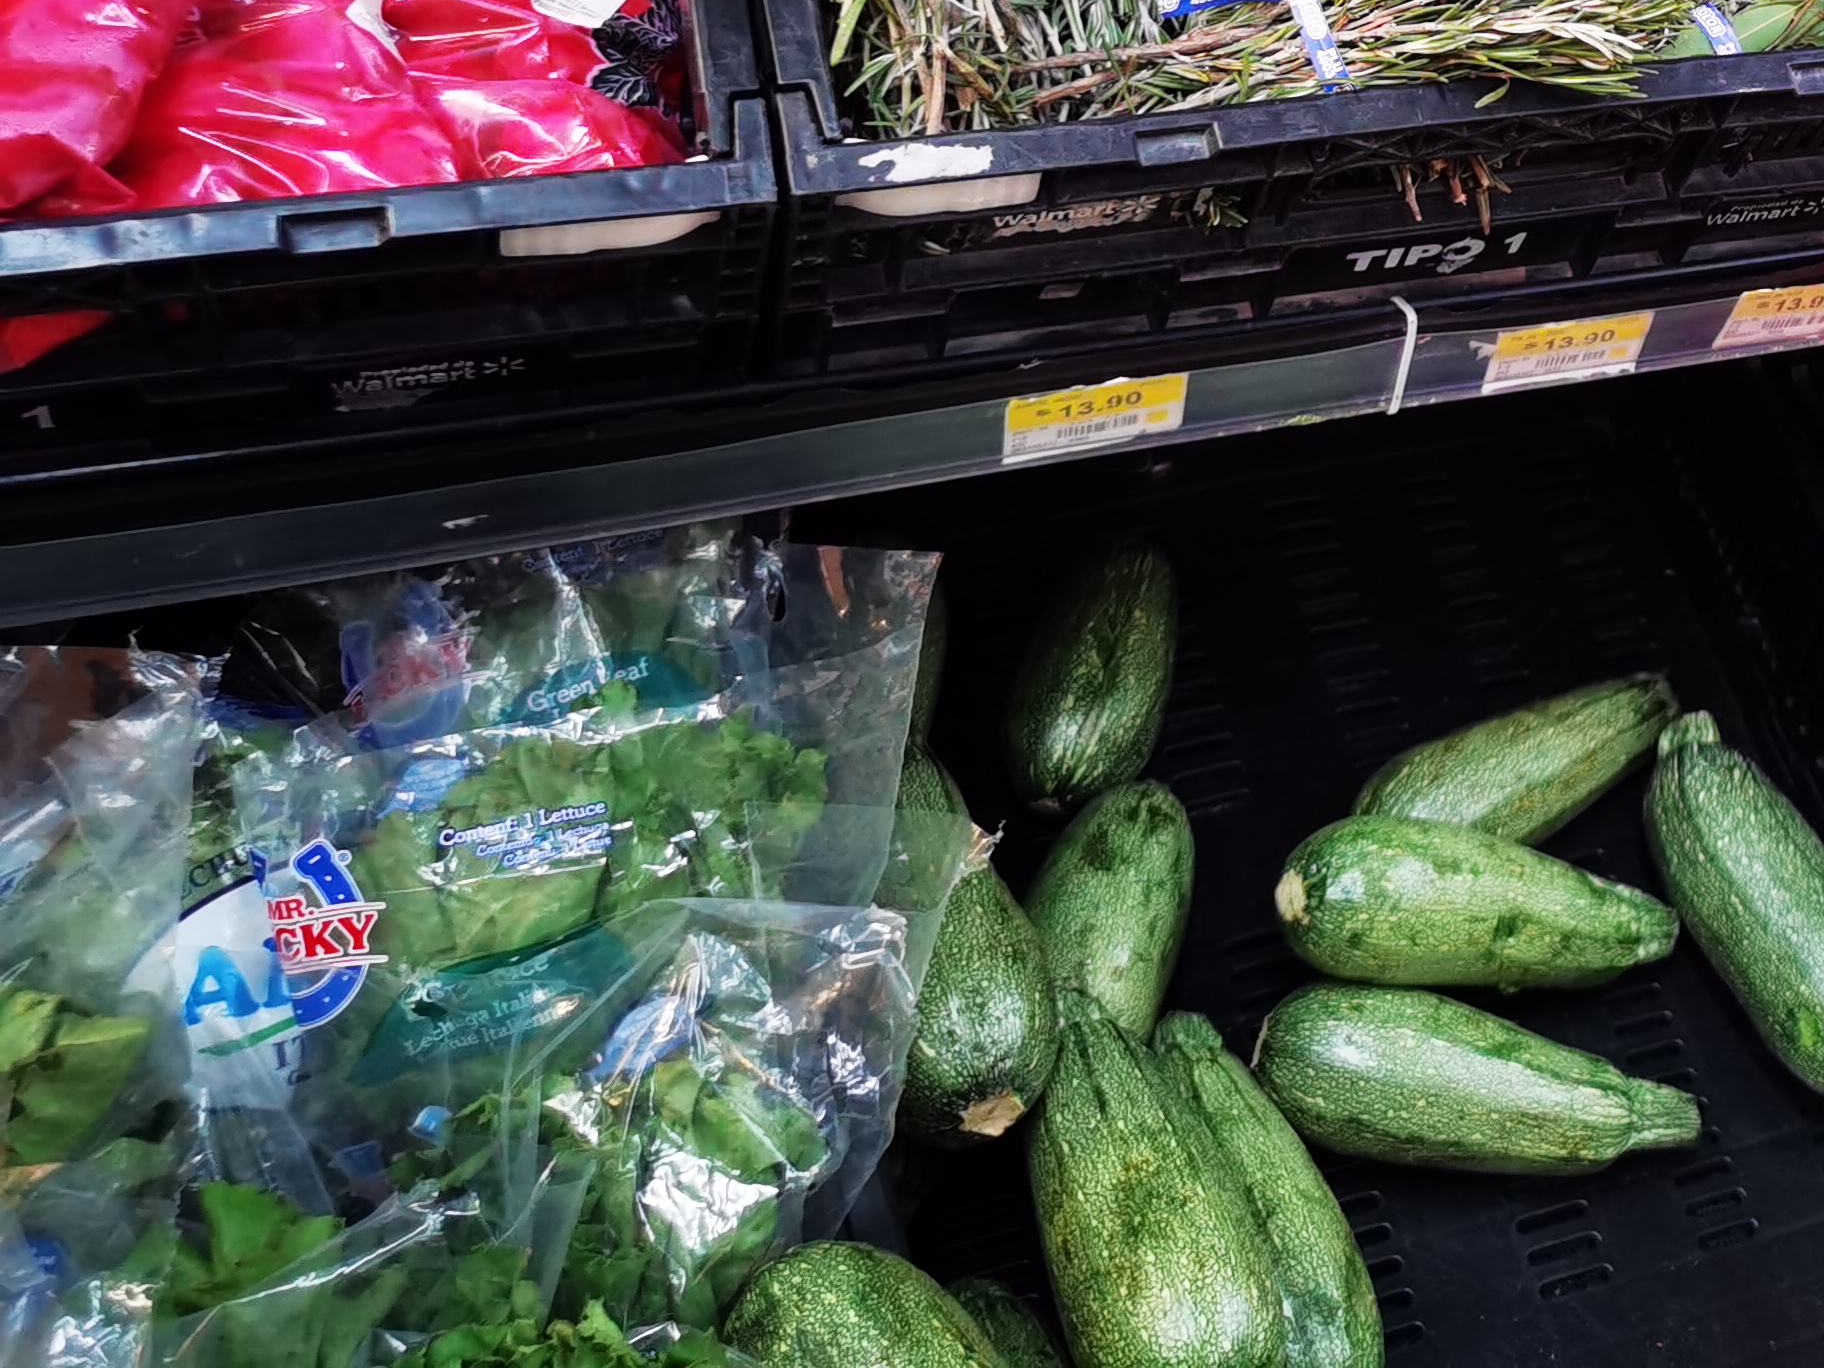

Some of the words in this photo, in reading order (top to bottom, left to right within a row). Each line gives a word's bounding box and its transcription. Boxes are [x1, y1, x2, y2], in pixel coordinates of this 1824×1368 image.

[993, 201, 1121, 229] Walmart
[1706, 204, 1802, 227] Walmart
[1345, 236, 1487, 273] TIPO
[1503, 231, 1529, 255] 1
[333, 366, 477, 395] Walmart
[20, 404, 57, 430] 1
[1058, 390, 1143, 418] 13.90
[527, 677, 599, 713] Green
[604, 655, 651, 684] eaf
[522, 811, 534, 829] 1
[538, 801, 608, 826] Lettuce
[266, 896, 318, 922] MR.
[274, 912, 378, 963] CKY
